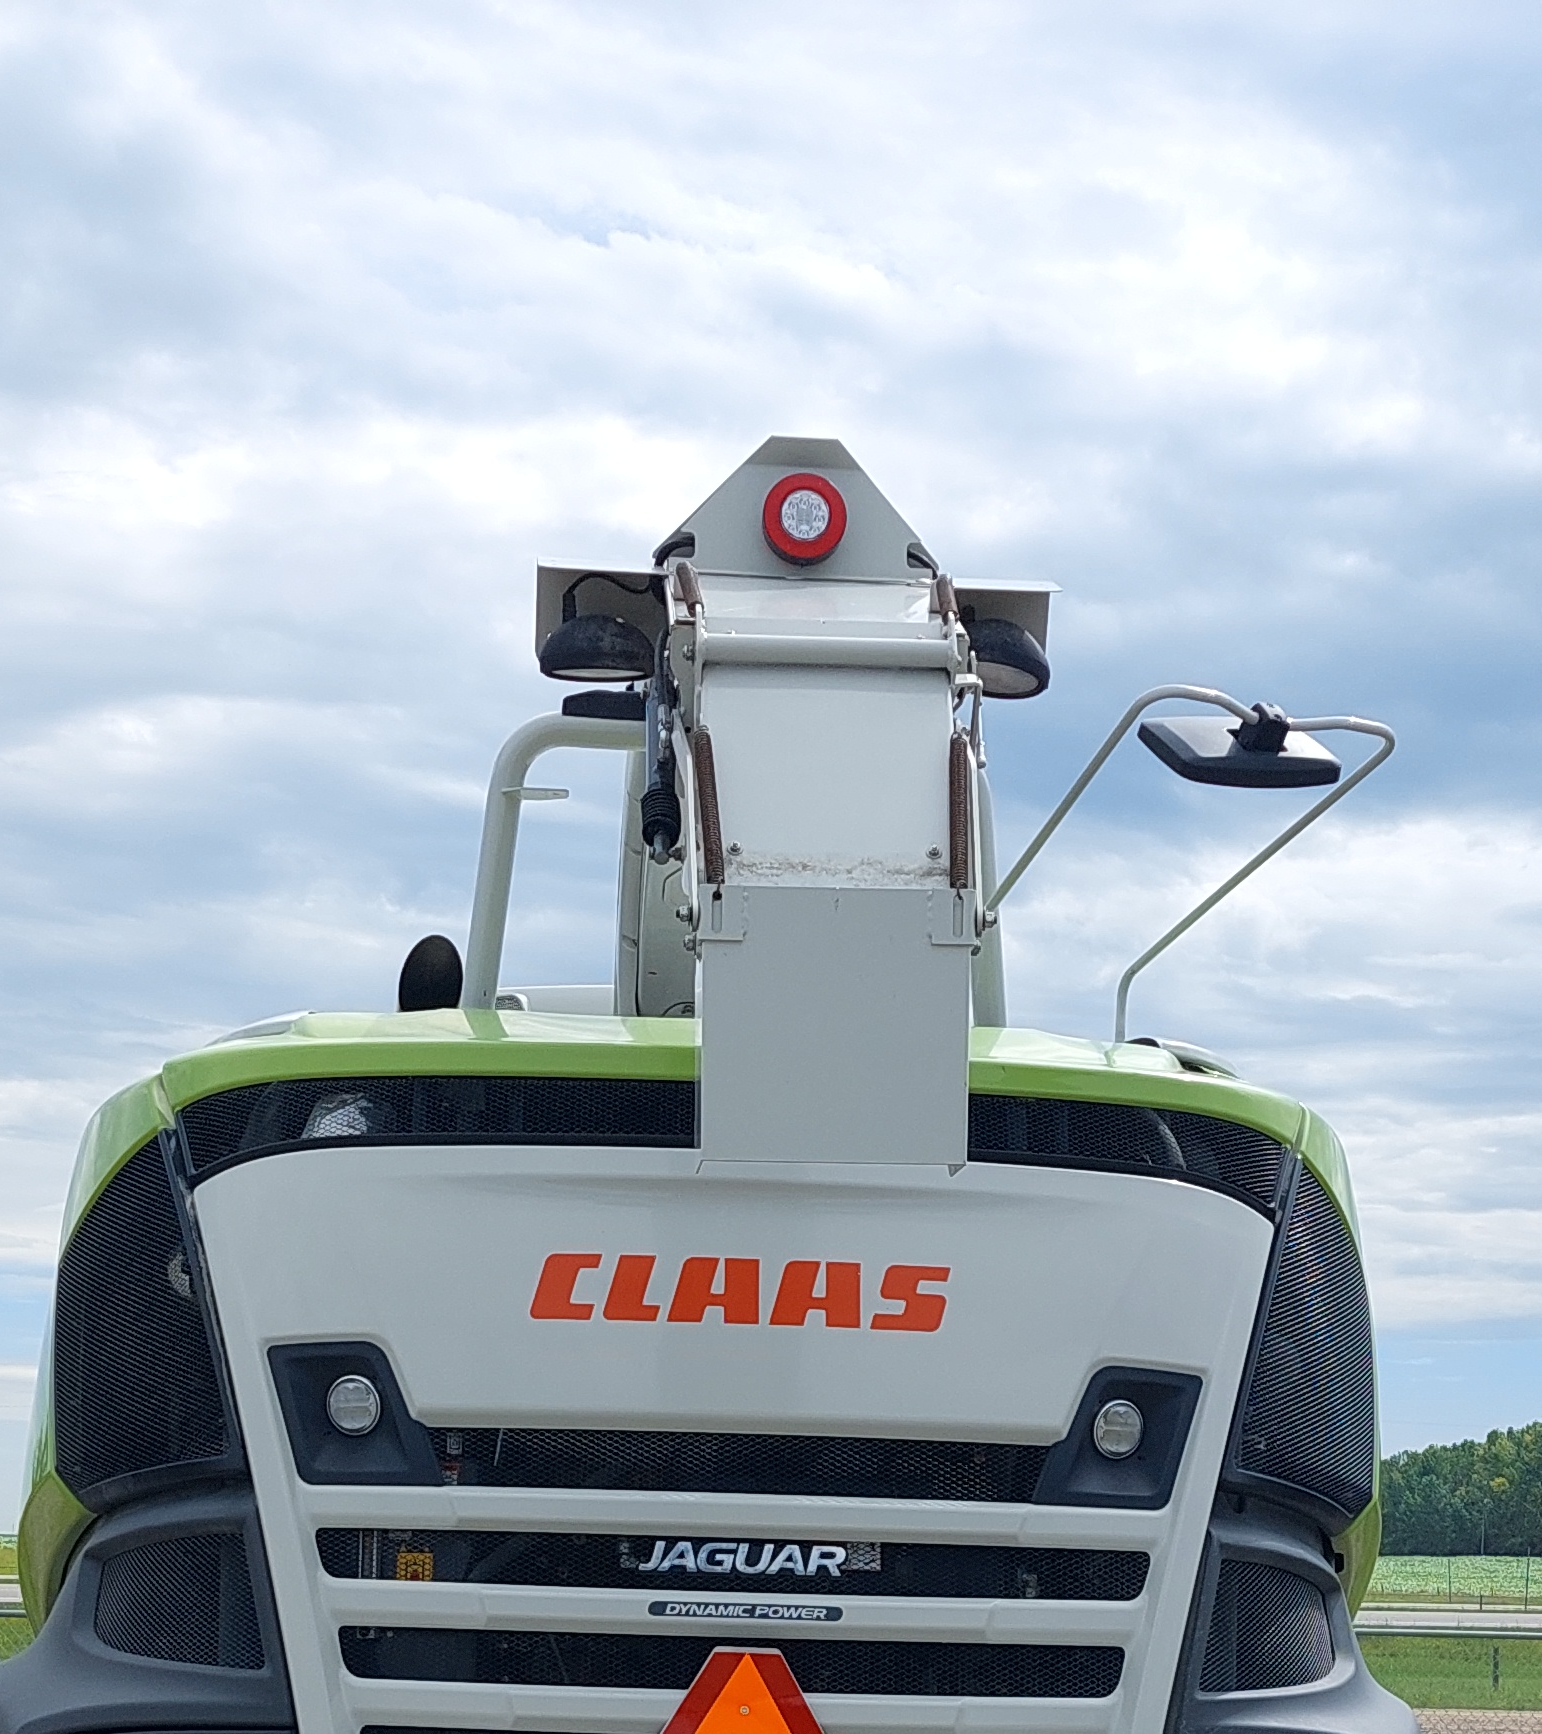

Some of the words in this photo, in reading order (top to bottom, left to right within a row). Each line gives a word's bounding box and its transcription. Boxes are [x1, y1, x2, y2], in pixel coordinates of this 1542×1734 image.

[529, 1252, 952, 1333] CLAAS
[638, 1540, 847, 1577] JAGUAR
[663, 1603, 752, 1617] DYNAMIC
[754, 1605, 828, 1620] POWER
